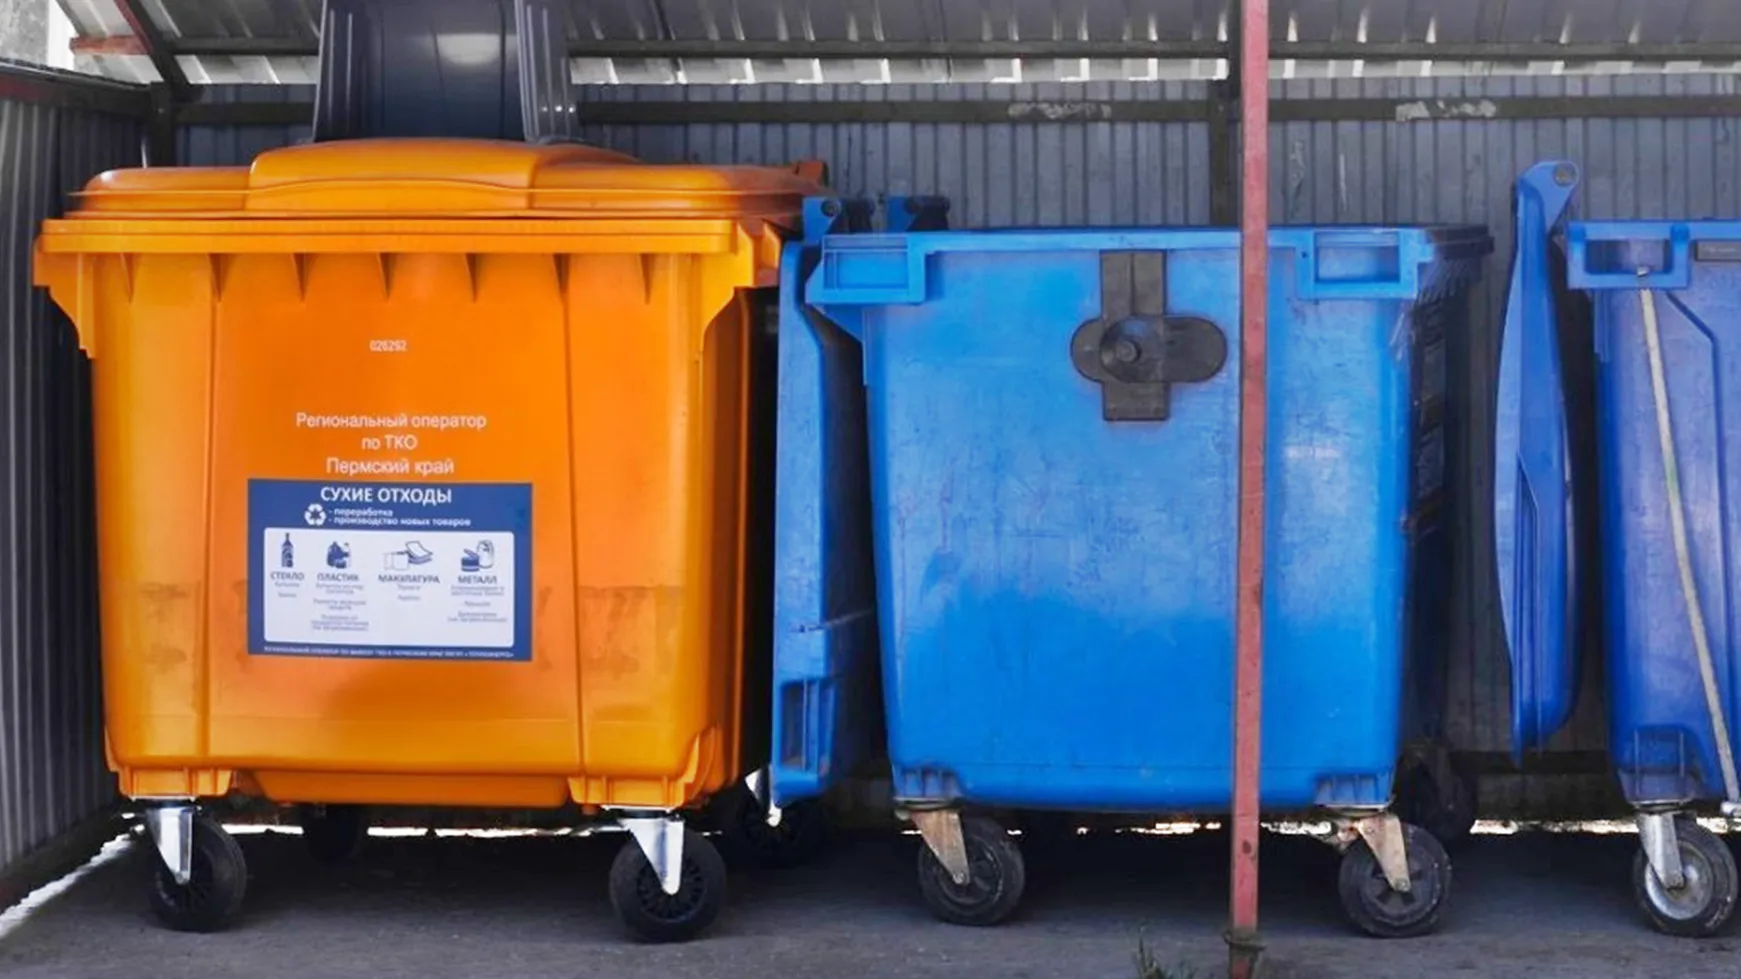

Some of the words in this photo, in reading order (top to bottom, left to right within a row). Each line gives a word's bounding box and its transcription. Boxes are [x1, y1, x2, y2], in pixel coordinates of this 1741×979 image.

[296, 412, 408, 429] Региональный
[411, 415, 487, 430] оператор
[362, 437, 381, 450] по
[385, 435, 418, 450] ТКО
[326, 457, 409, 476] Пермский
[415, 459, 454, 474] край
[320, 487, 373, 502] СУХИЕ
[377, 488, 452, 506] ОТХОДЫ
[334, 507, 394, 517] переработка
[334, 517, 398, 526] производство
[432, 519, 471, 528] товаров
[270, 571, 305, 581] СТЕКЛО
[317, 572, 360, 583] ПЛАСТИК
[378, 574, 440, 584] МАКУЛАТУРА
[457, 575, 498, 584] МЕТАЛЛ
